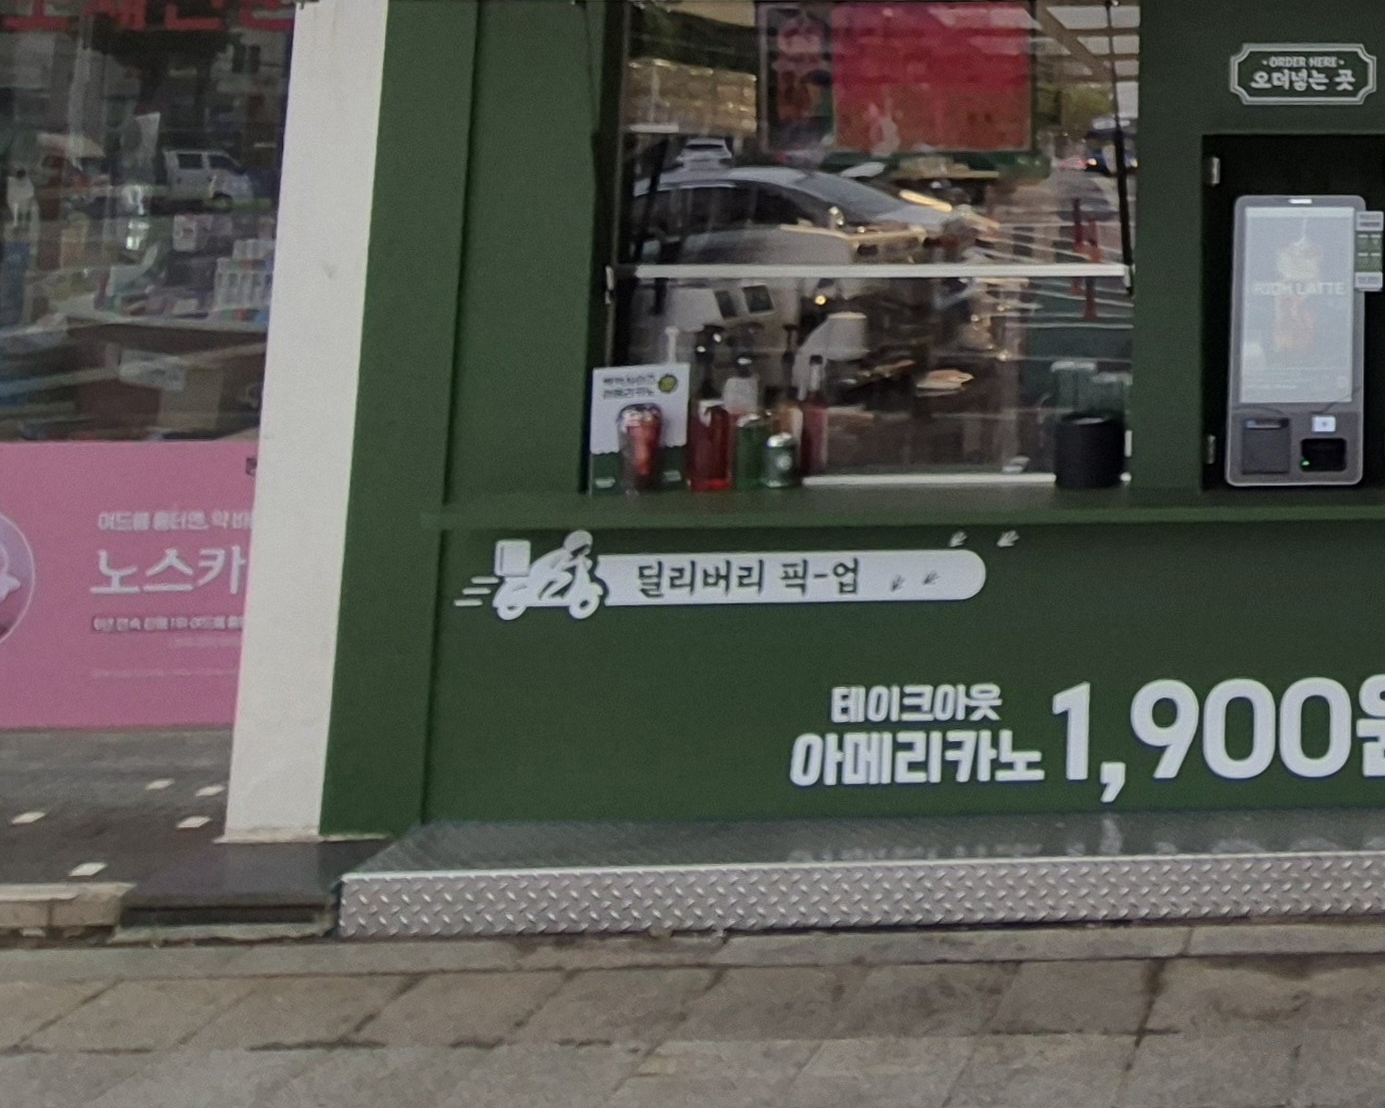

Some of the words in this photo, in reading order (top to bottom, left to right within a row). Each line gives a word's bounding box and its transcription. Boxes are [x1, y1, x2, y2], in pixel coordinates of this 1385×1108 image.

[1268, 56, 1307, 68] ORDER
[1308, 56, 1338, 68] HERE
[1333, 69, 1356, 91] 곳
[89, 544, 247, 595] 노스카
[637, 558, 764, 598] 딜리버리
[779, 556, 860, 595] 픽-업
[830, 683, 1003, 723] 테이크아웃
[788, 729, 1045, 787] 아메리카노
